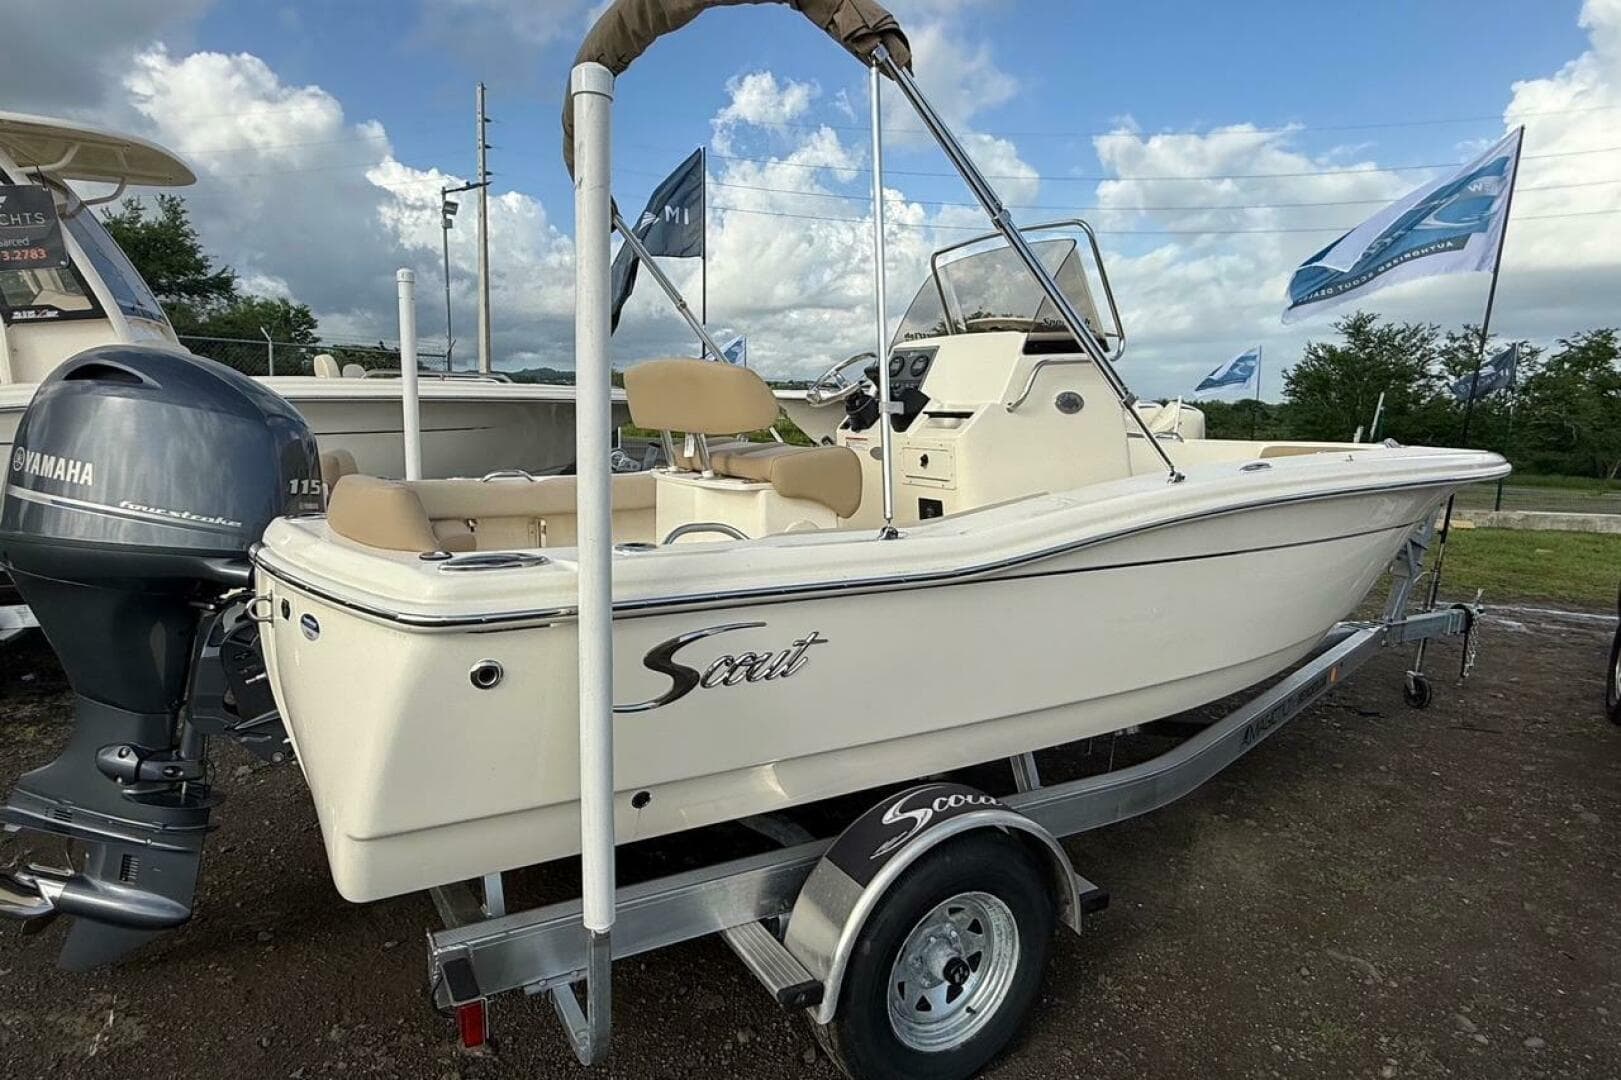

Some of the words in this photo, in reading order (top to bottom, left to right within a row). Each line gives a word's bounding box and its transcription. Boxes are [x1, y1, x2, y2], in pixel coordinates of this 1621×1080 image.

[25, 450, 94, 486] YAMAHA
[289, 479, 321, 495] 115
[613, 621, 829, 713] Scout
